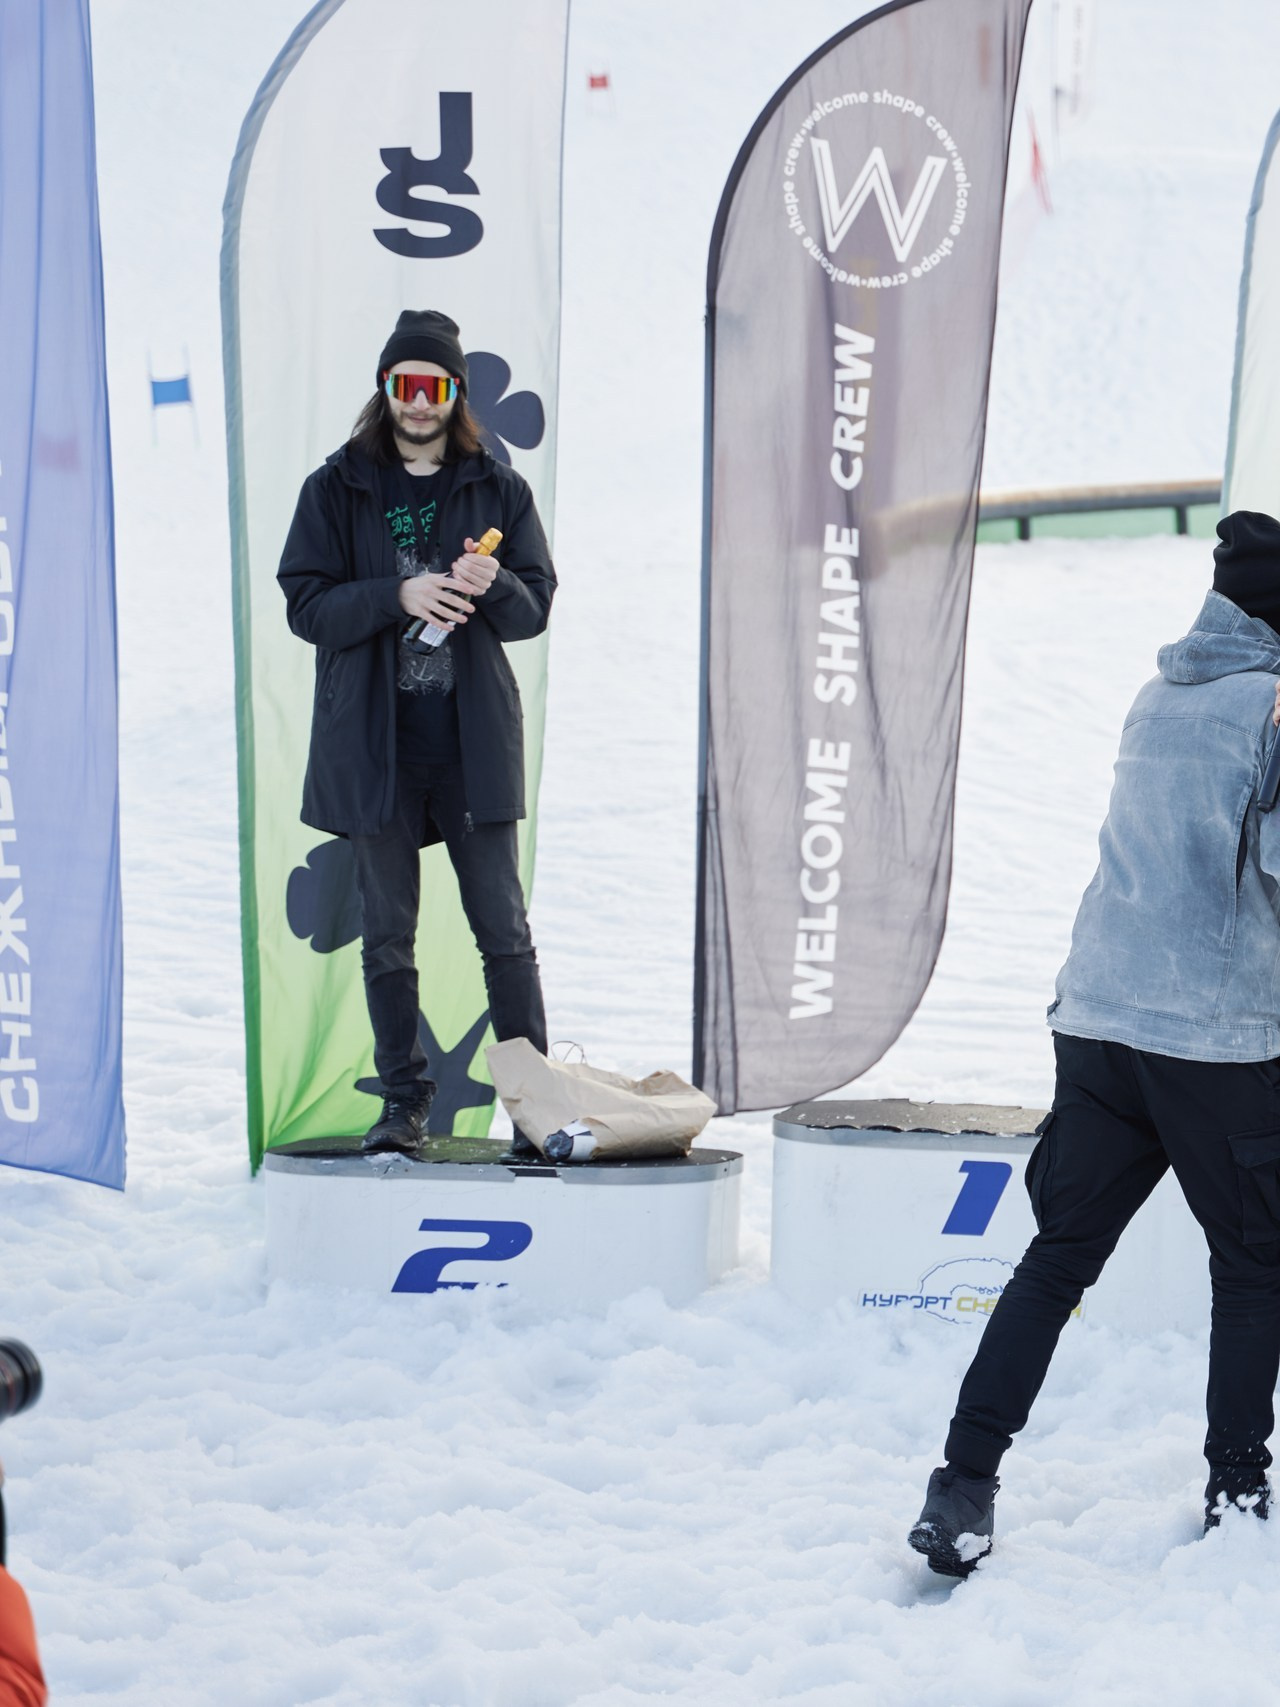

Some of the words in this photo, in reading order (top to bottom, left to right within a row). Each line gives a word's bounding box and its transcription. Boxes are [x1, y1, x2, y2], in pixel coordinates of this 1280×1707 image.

[802, 90, 869, 131] welcome
[873, 89, 925, 118] shape
[784, 133, 806, 177] crew
[925, 115, 958, 152] crew
[783, 180, 806, 236] shape
[948, 157, 972, 236] welcome
[802, 236, 861, 288] welcome
[866, 271, 909, 289] crew
[911, 237, 954, 278] shape
[830, 323, 877, 491] CREW
[813, 523, 860, 707] SHAPE
[789, 737, 851, 1021] WELCOME
[941, 1160, 1013, 1236] 1
[391, 1218, 533, 1294] 2
